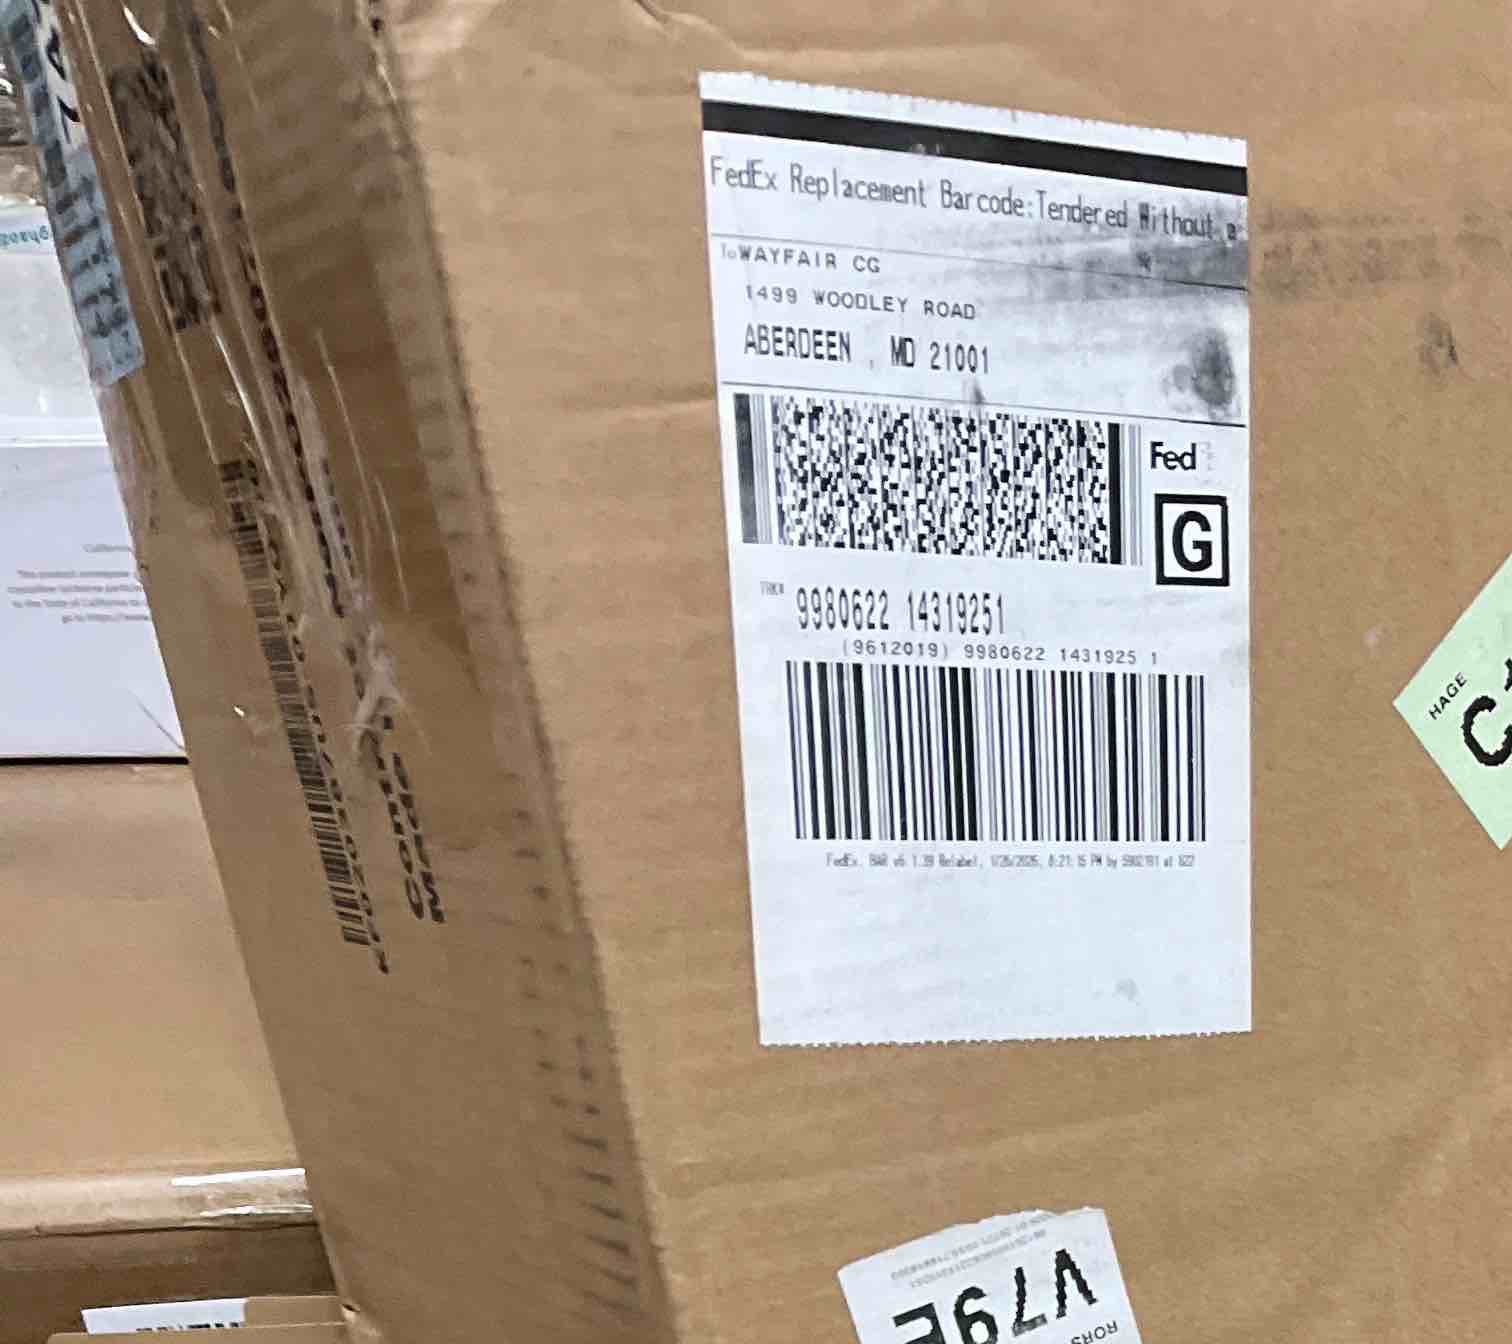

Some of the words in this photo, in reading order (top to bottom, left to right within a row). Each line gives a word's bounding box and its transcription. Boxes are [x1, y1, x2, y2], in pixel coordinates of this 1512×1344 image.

[710, 155, 777, 190] FedEx
[790, 163, 926, 207] Replacement
[1139, 202, 1213, 239] Without
[738, 244, 837, 269] WAYFAIR
[852, 254, 881, 273] CG
[746, 284, 798, 304] 1499
[813, 288, 908, 312] WOODLEY
[924, 299, 976, 320] ROAD
[744, 323, 852, 363] ABERDEEN
[891, 334, 916, 368] MD
[930, 340, 989, 374] 21001
[1171, 510, 1214, 573] G
[797, 587, 890, 632] 9980622
[907, 590, 1007, 635] 14319251
[842, 638, 949, 660] (9612019)
[963, 643, 1046, 662] 9980622
[1060, 648, 1137, 666] 1431925
[1428, 672, 1468, 721] HAGE
